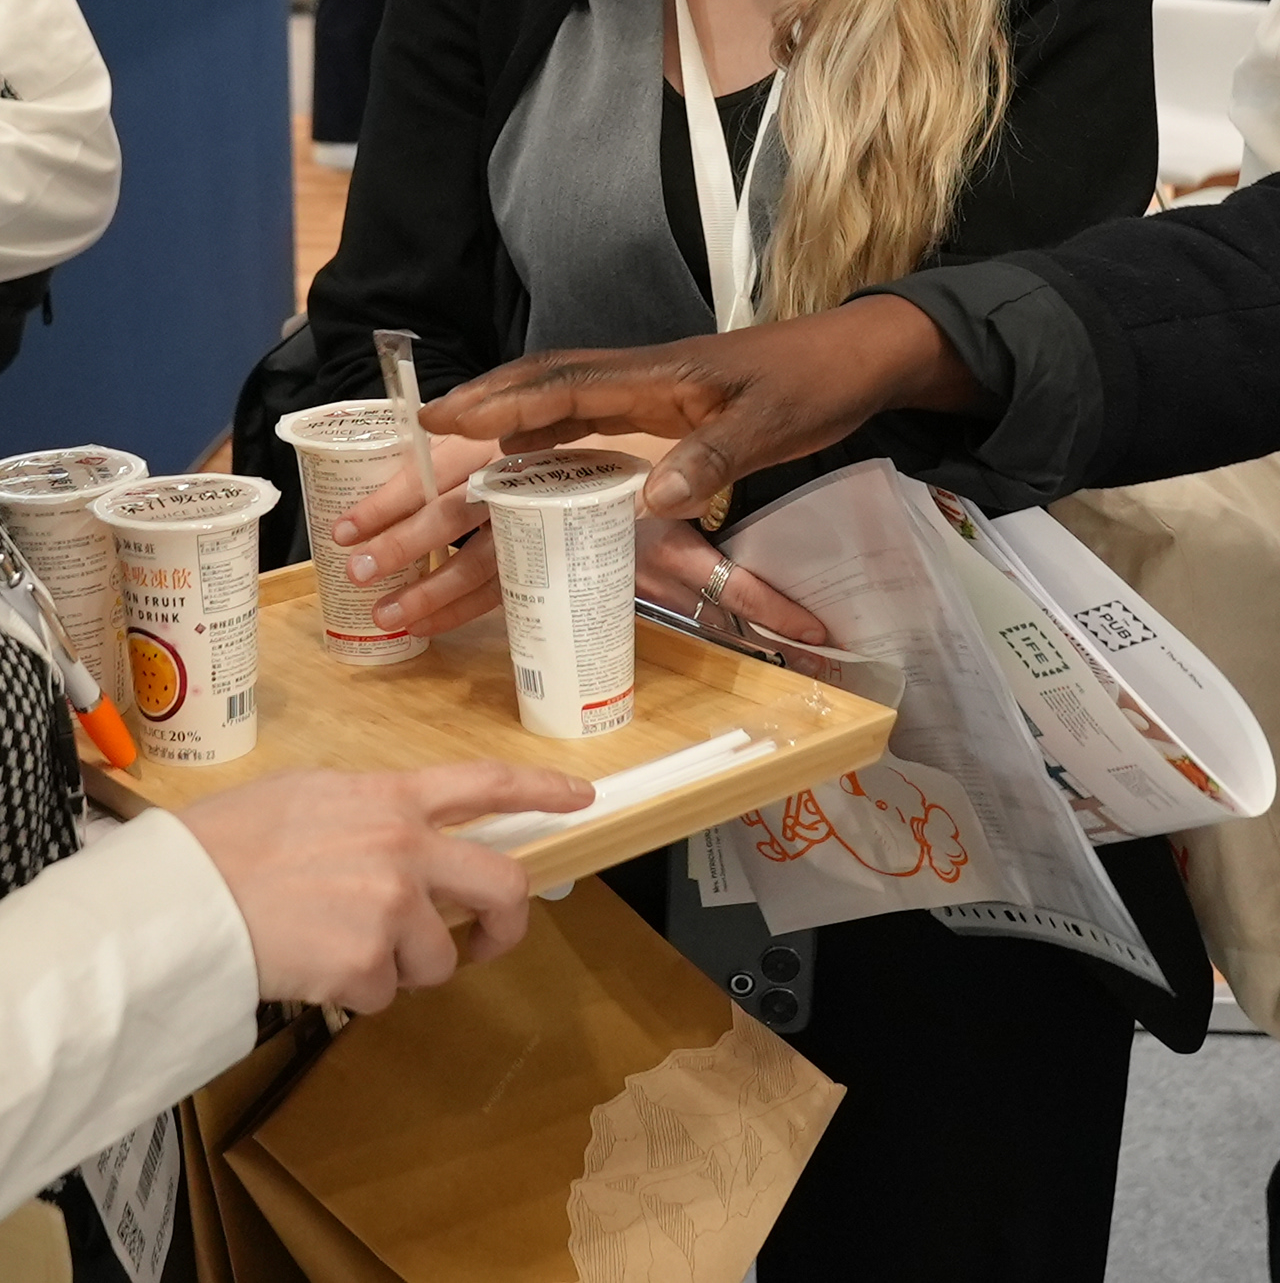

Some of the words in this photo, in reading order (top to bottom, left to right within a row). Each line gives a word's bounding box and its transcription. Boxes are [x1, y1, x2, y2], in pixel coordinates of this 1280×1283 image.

[145, 594, 186, 608] FRUIT
[138, 609, 181, 624] DRINK
[1099, 612, 1132, 639] PUB
[1021, 635, 1050, 665] IFE
[168, 729, 202, 743] 20%
